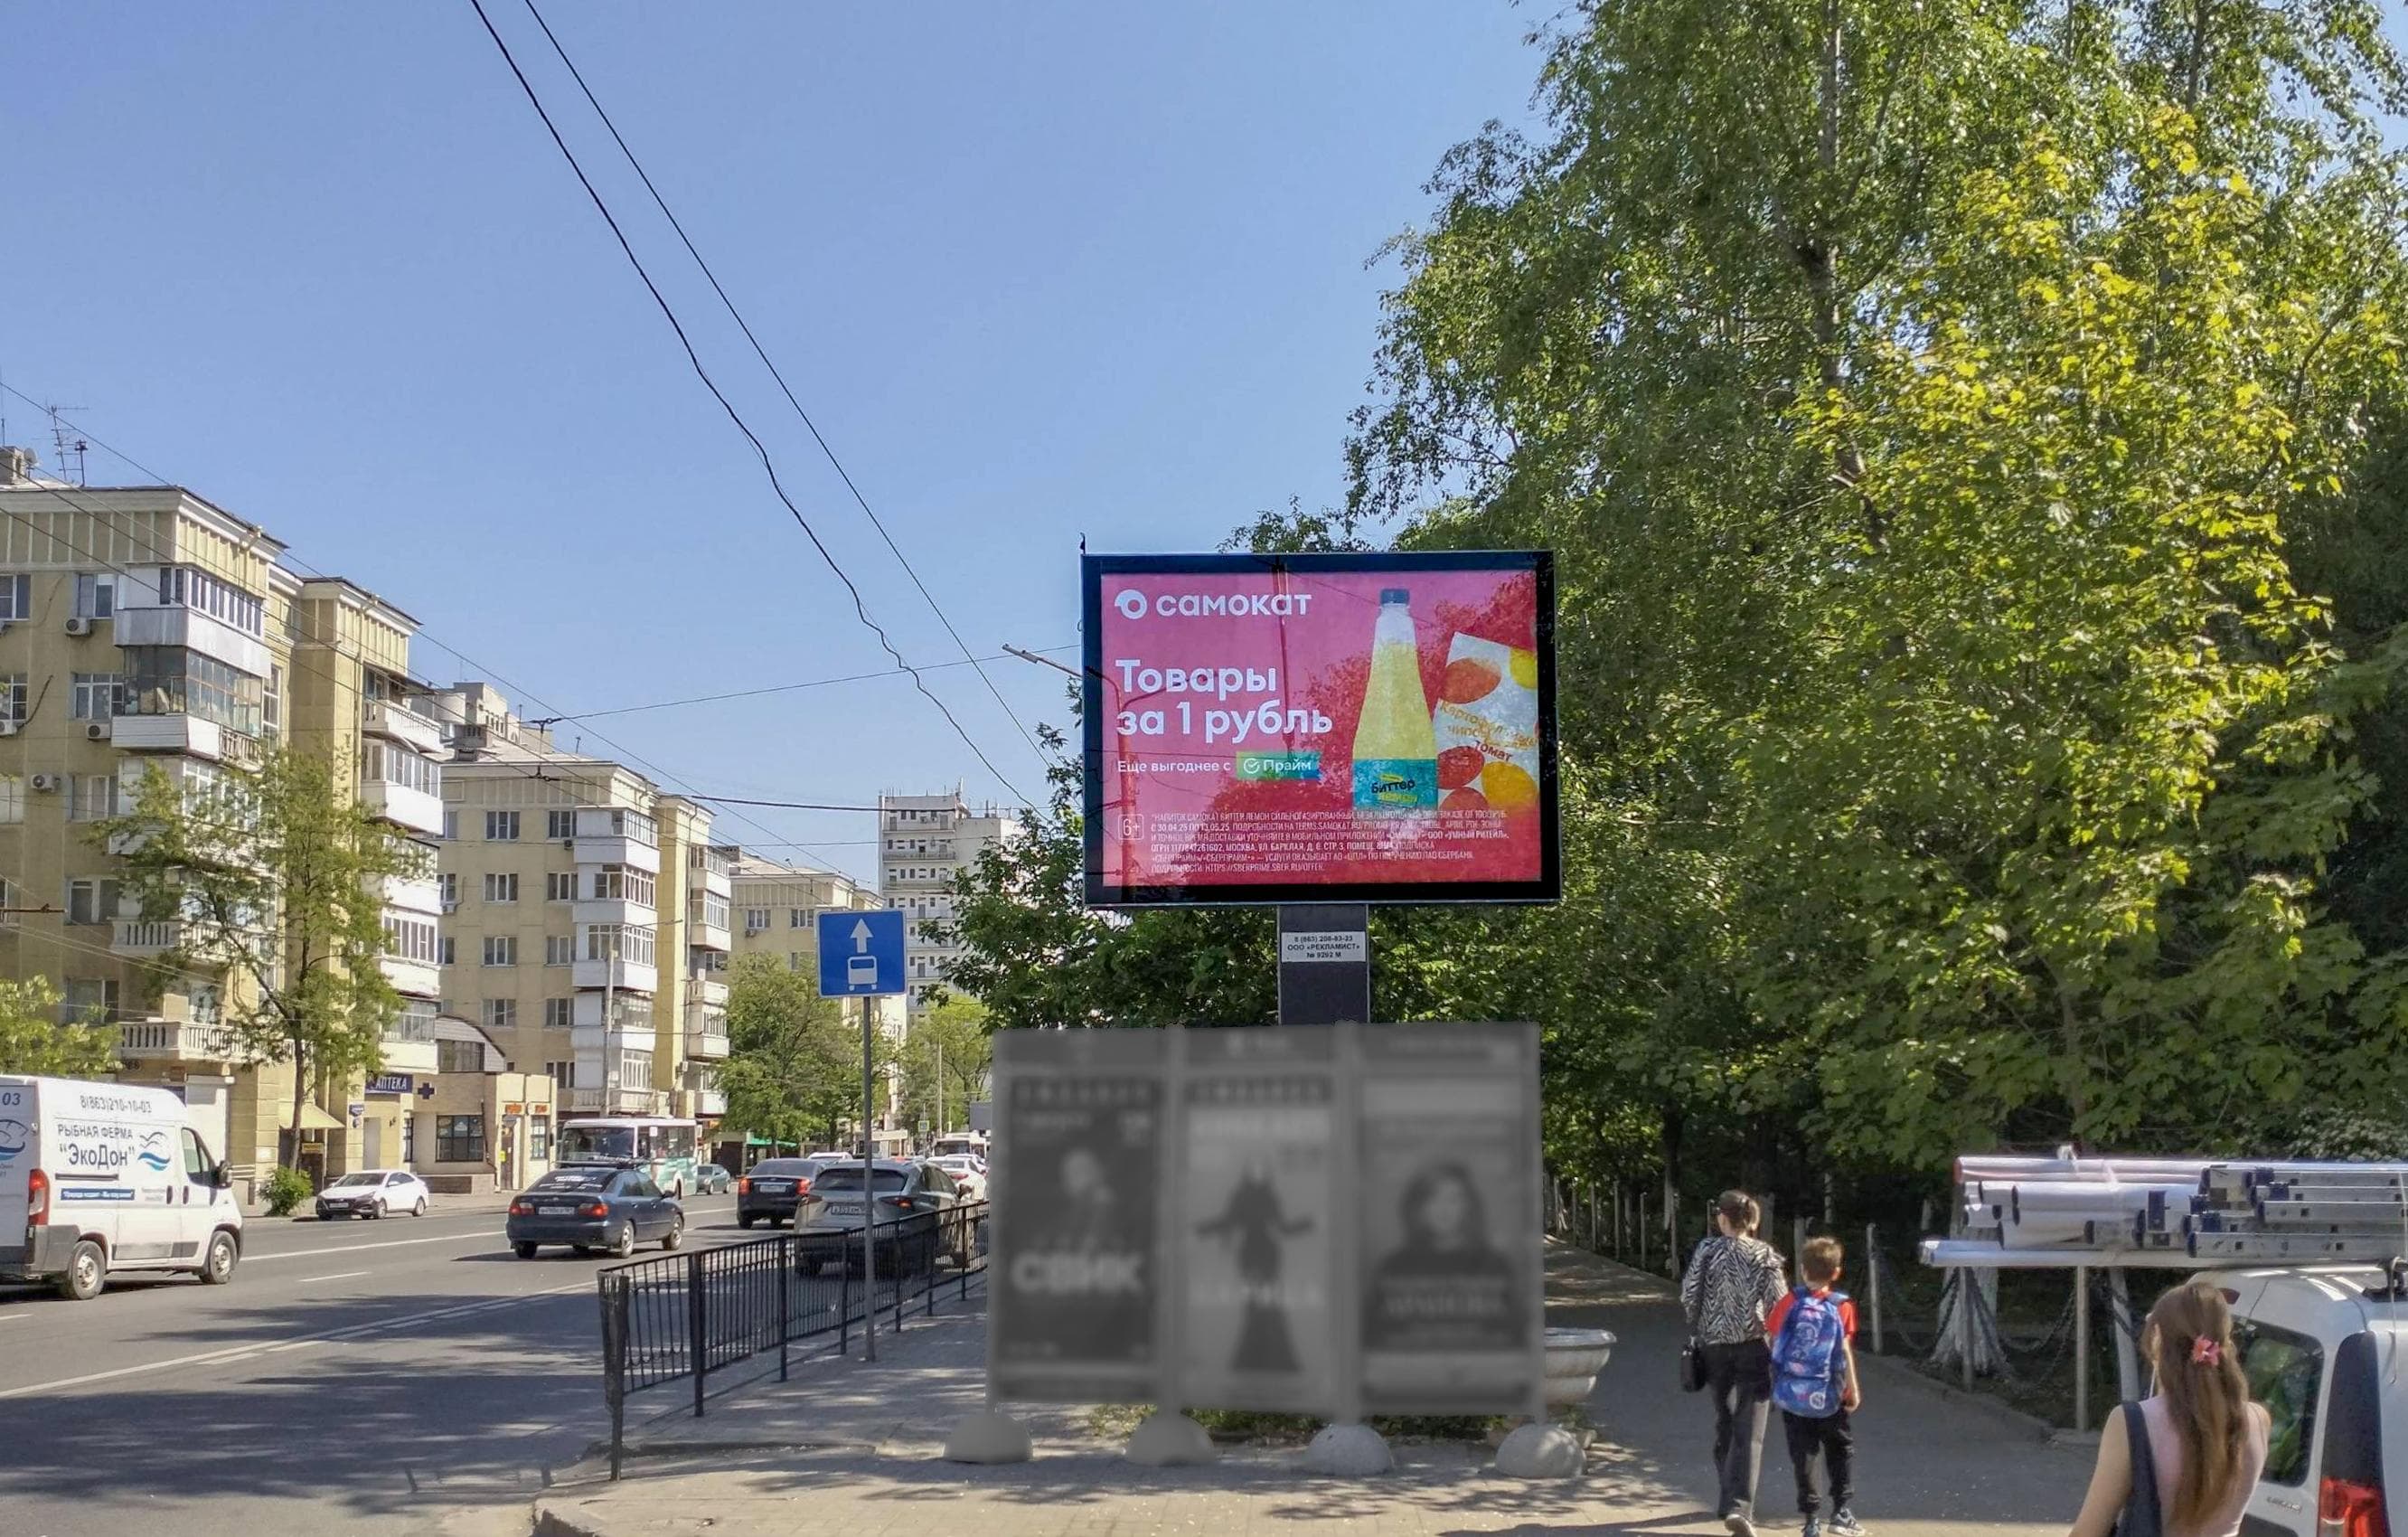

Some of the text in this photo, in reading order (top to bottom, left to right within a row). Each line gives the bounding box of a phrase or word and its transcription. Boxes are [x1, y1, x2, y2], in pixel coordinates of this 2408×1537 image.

[1156, 594, 1312, 617] самокат
[1115, 659, 1277, 701] Товары
[1116, 699, 1333, 744] за 1 рубль
[1117, 760, 1231, 775] Еще выгоднее с
[1263, 757, 1312, 773] Прайм
[1123, 817, 1142, 837] 6+
[376, 1076, 408, 1090] АПТЕКА
[2, 1092, 22, 1106] 03
[57, 1124, 133, 1139] РЫБНАЯ ФЕРМА
